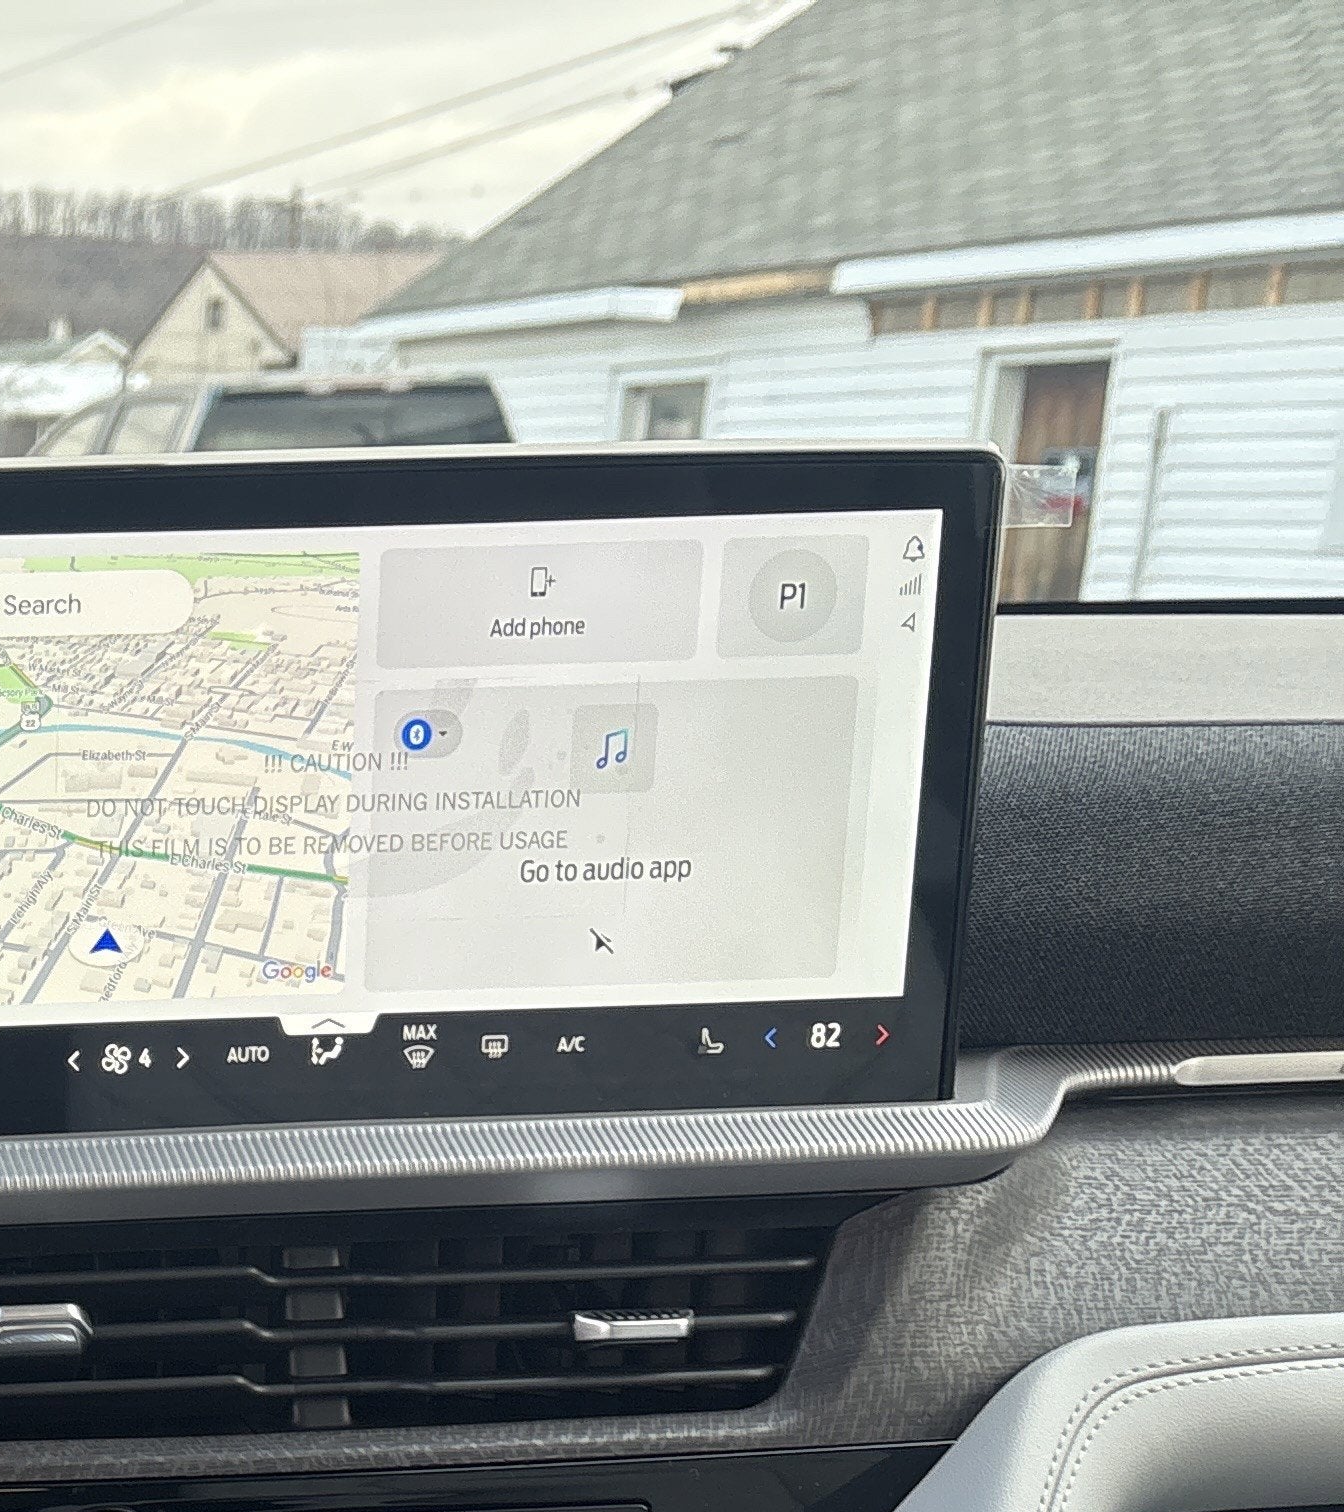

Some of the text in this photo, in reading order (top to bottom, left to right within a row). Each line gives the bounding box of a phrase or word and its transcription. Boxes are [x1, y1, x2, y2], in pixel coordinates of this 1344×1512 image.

[3, 594, 82, 615] Search
[778, 583, 808, 611] P1
[489, 616, 587, 641] Add phone
[25, 719, 36, 728] 22
[192, 712, 211, 734] Main
[210, 701, 222, 714] St
[82, 749, 147, 762] Elizabeth St
[264, 752, 409, 774] !!! CAUTION !!!
[86, 788, 582, 818] DO NOT TOUCH DISPLAY DURING INSTALLATION
[1, 806, 63, 839] Charles St
[97, 830, 569, 858] THIS FILM IS TO BE REMOVED BEFORE USAGE
[181, 855, 229, 873] Charles
[230, 861, 247, 874] St
[520, 857, 692, 885] Go to audio app
[11, 870, 54, 929] Lehigh Aly
[67, 883, 103, 934] S Main St
[262, 960, 332, 982] Google
[402, 1025, 437, 1042] MAX
[556, 1035, 586, 1054] A/C
[810, 1024, 841, 1048] 82
[138, 1048, 152, 1068] 4
[226, 1046, 270, 1063] AUTO
